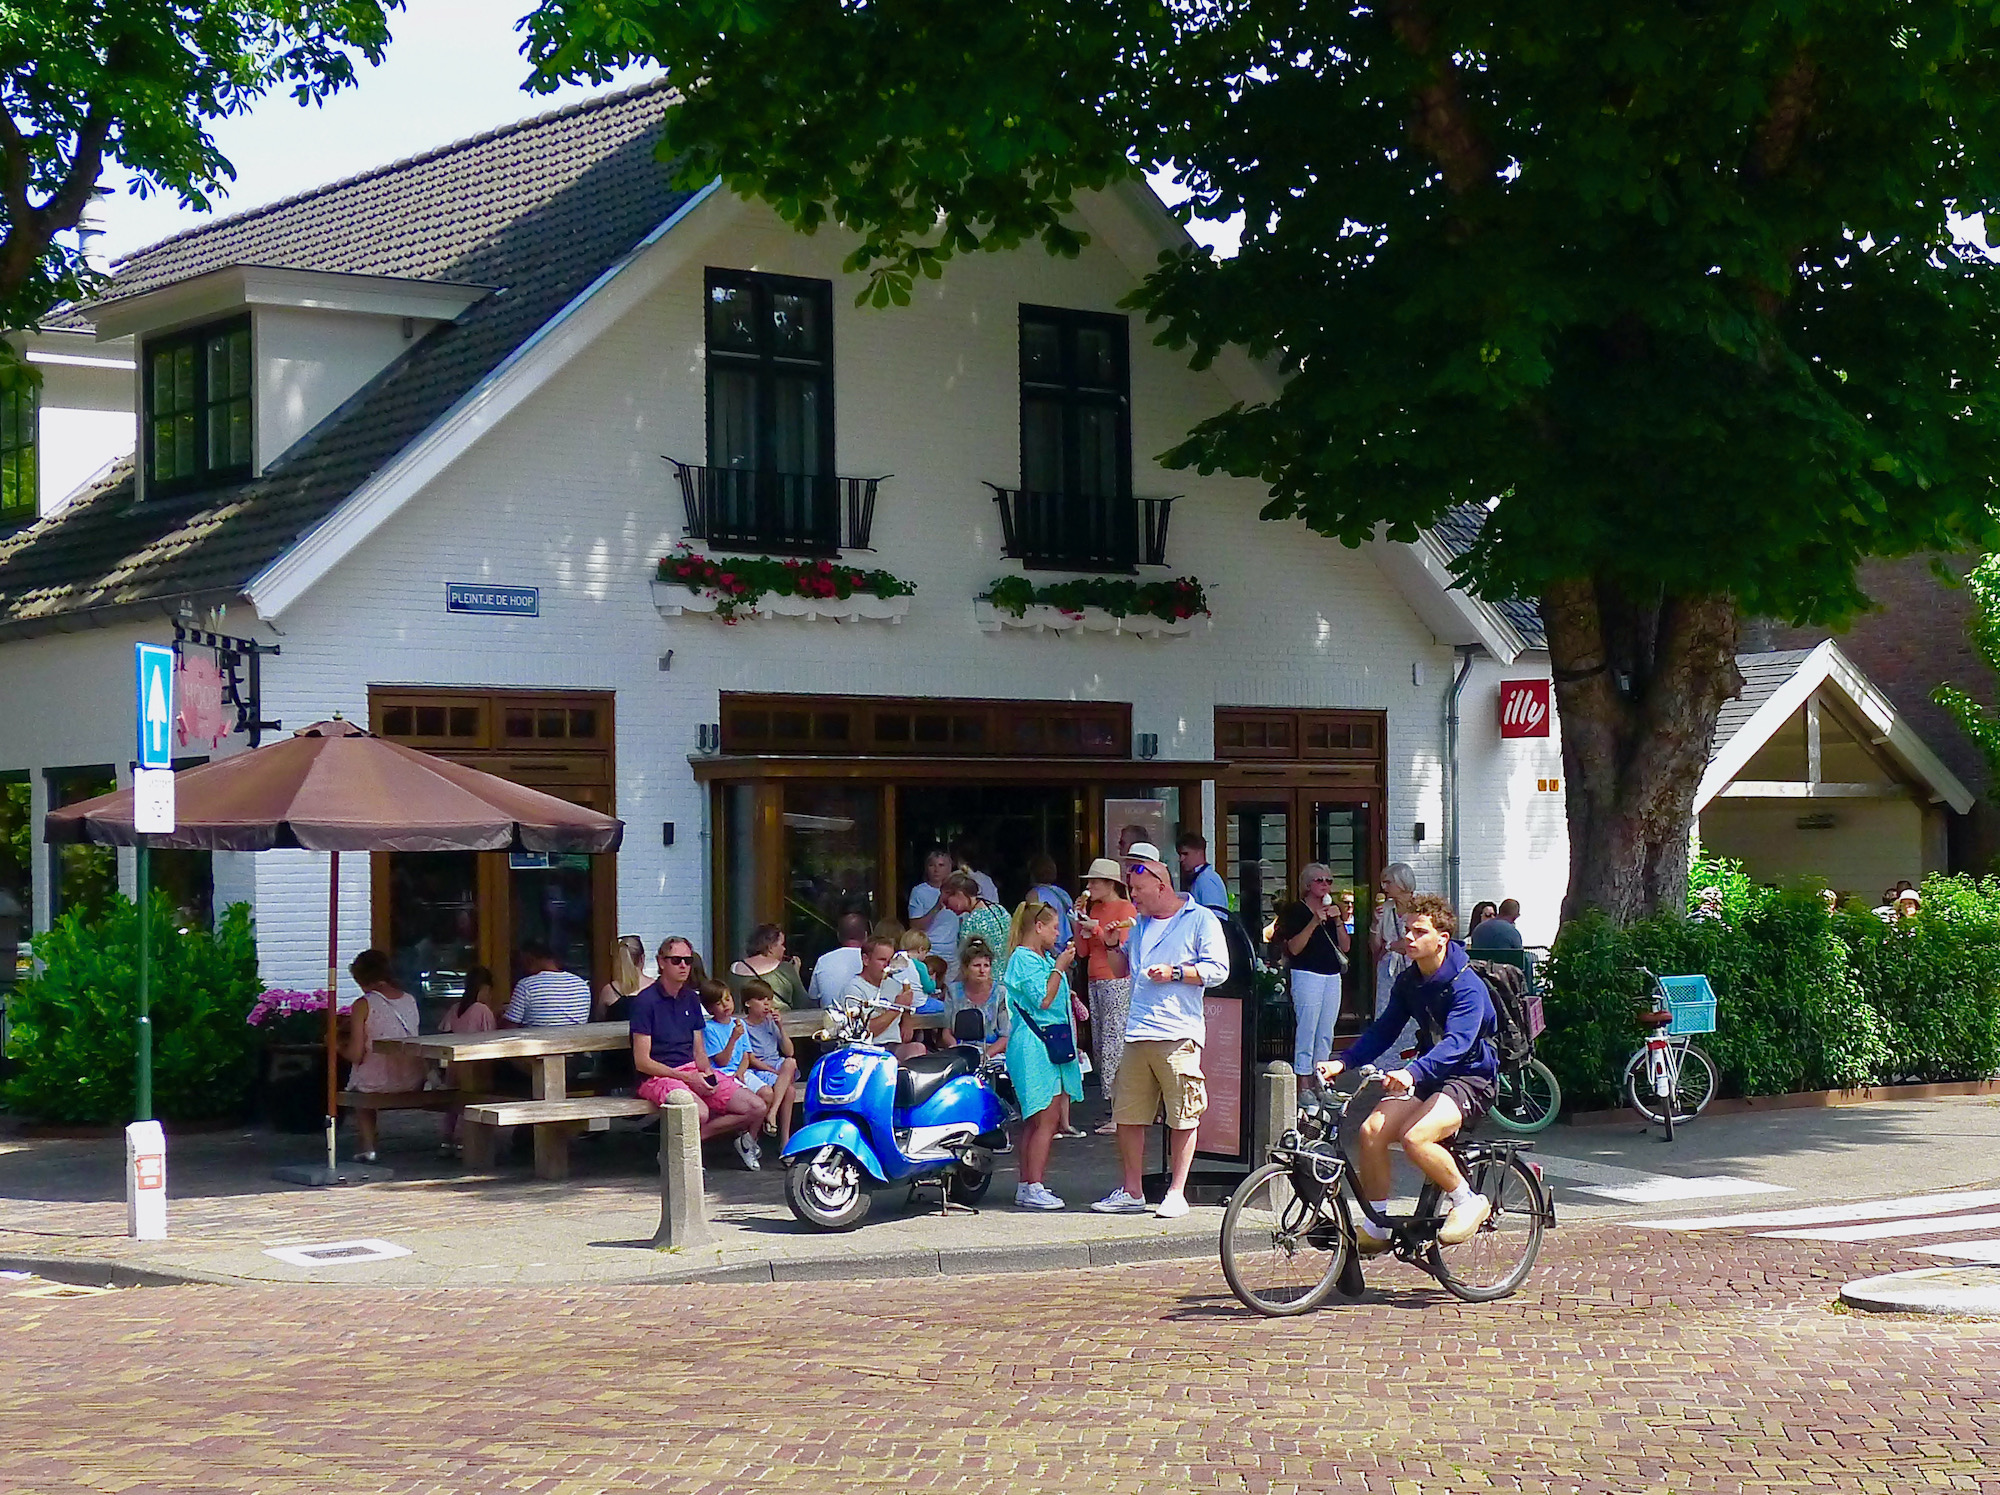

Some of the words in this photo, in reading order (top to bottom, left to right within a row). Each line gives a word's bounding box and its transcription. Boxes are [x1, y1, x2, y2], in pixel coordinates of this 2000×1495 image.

[452, 592, 494, 605] PLEINTJE
[496, 594, 508, 606] DE
[510, 596, 534, 607] HOOP
[1503, 688, 1546, 733] illy
[1204, 1004, 1223, 1016] OOP
